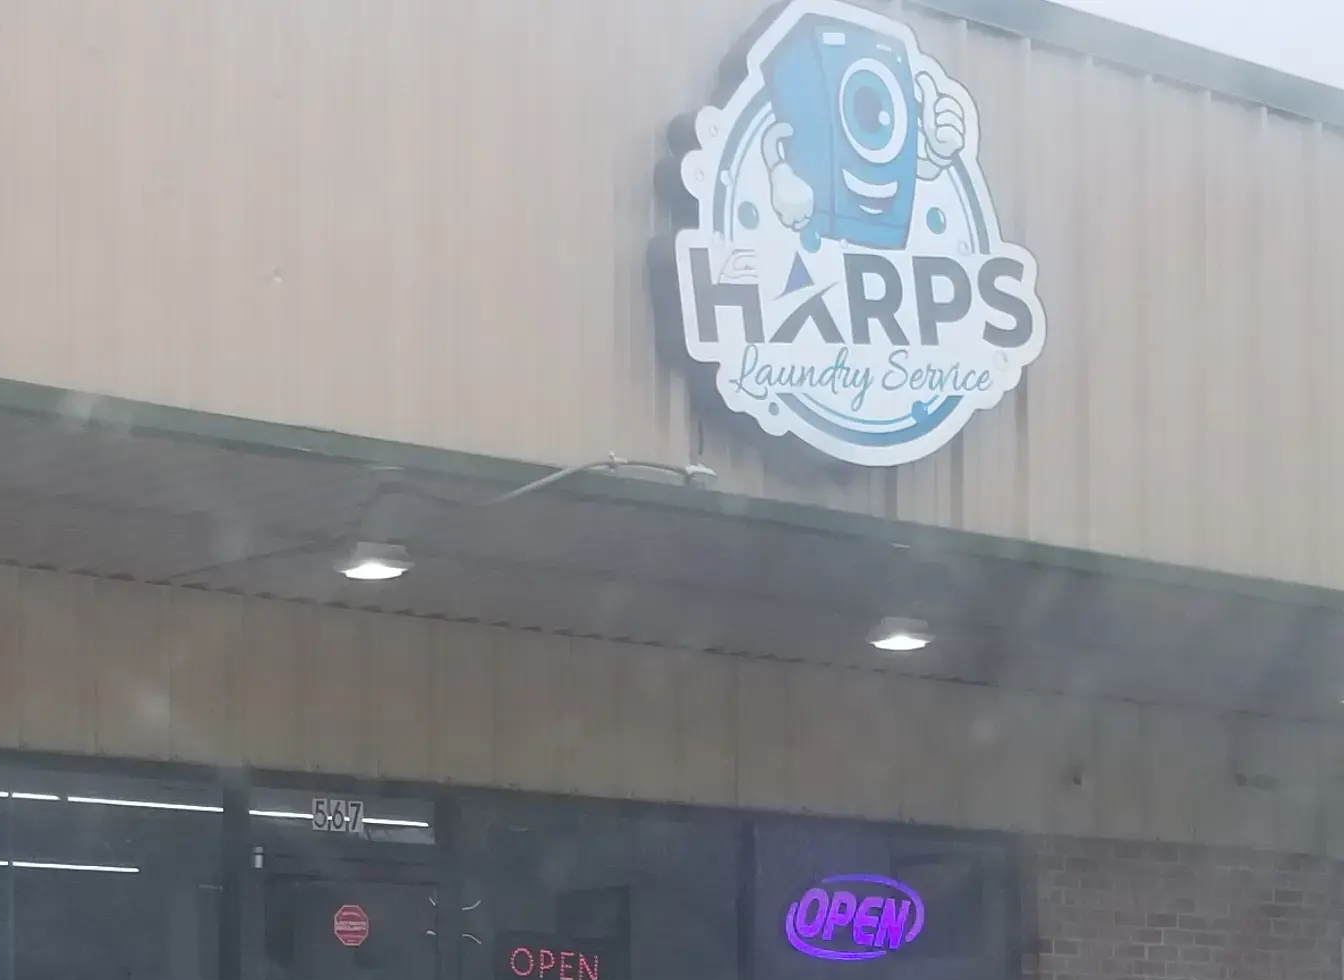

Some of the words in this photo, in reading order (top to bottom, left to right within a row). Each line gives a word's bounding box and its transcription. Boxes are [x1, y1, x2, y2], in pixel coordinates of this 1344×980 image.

[688, 247, 1034, 348] HARPS
[728, 344, 874, 412] Laundry
[882, 349, 994, 392] Service
[314, 800, 362, 830] 567
[795, 887, 911, 949] OPEN
